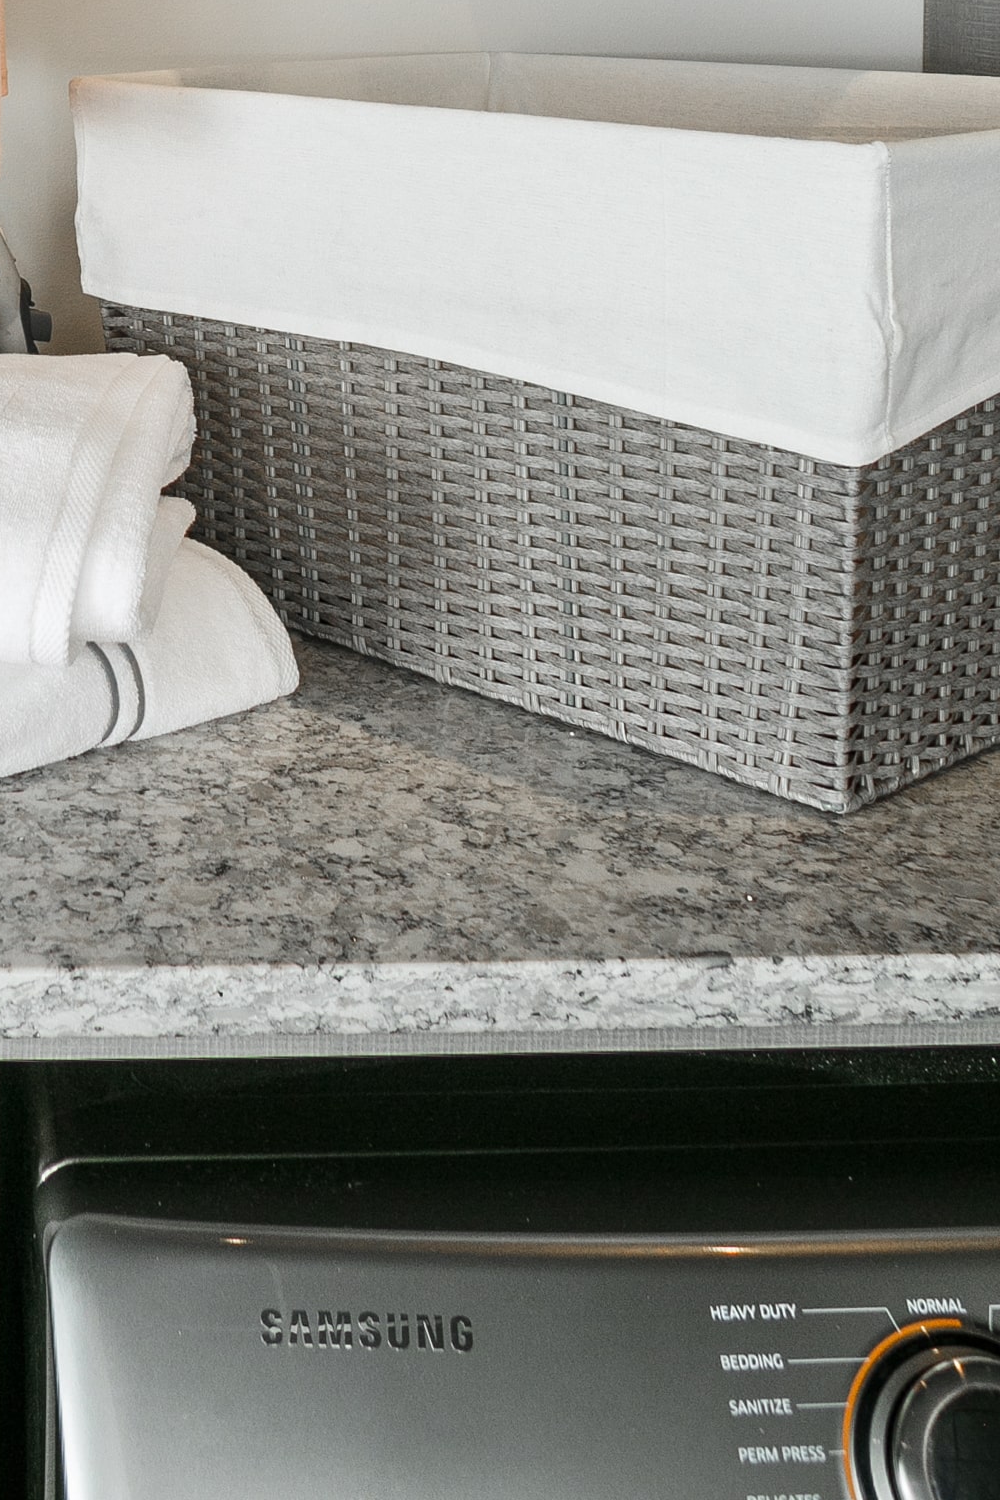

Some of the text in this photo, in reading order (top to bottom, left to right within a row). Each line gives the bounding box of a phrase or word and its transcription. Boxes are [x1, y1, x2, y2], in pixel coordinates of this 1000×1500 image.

[710, 1303, 796, 1321] HEAVY DUTY
[906, 1298, 967, 1314] NORMAL
[259, 1308, 475, 1353] SAMSUNG
[720, 1353, 785, 1371] BEDDING
[729, 1398, 793, 1416] SANITIZE
[738, 1445, 827, 1464] PERM PRESS
